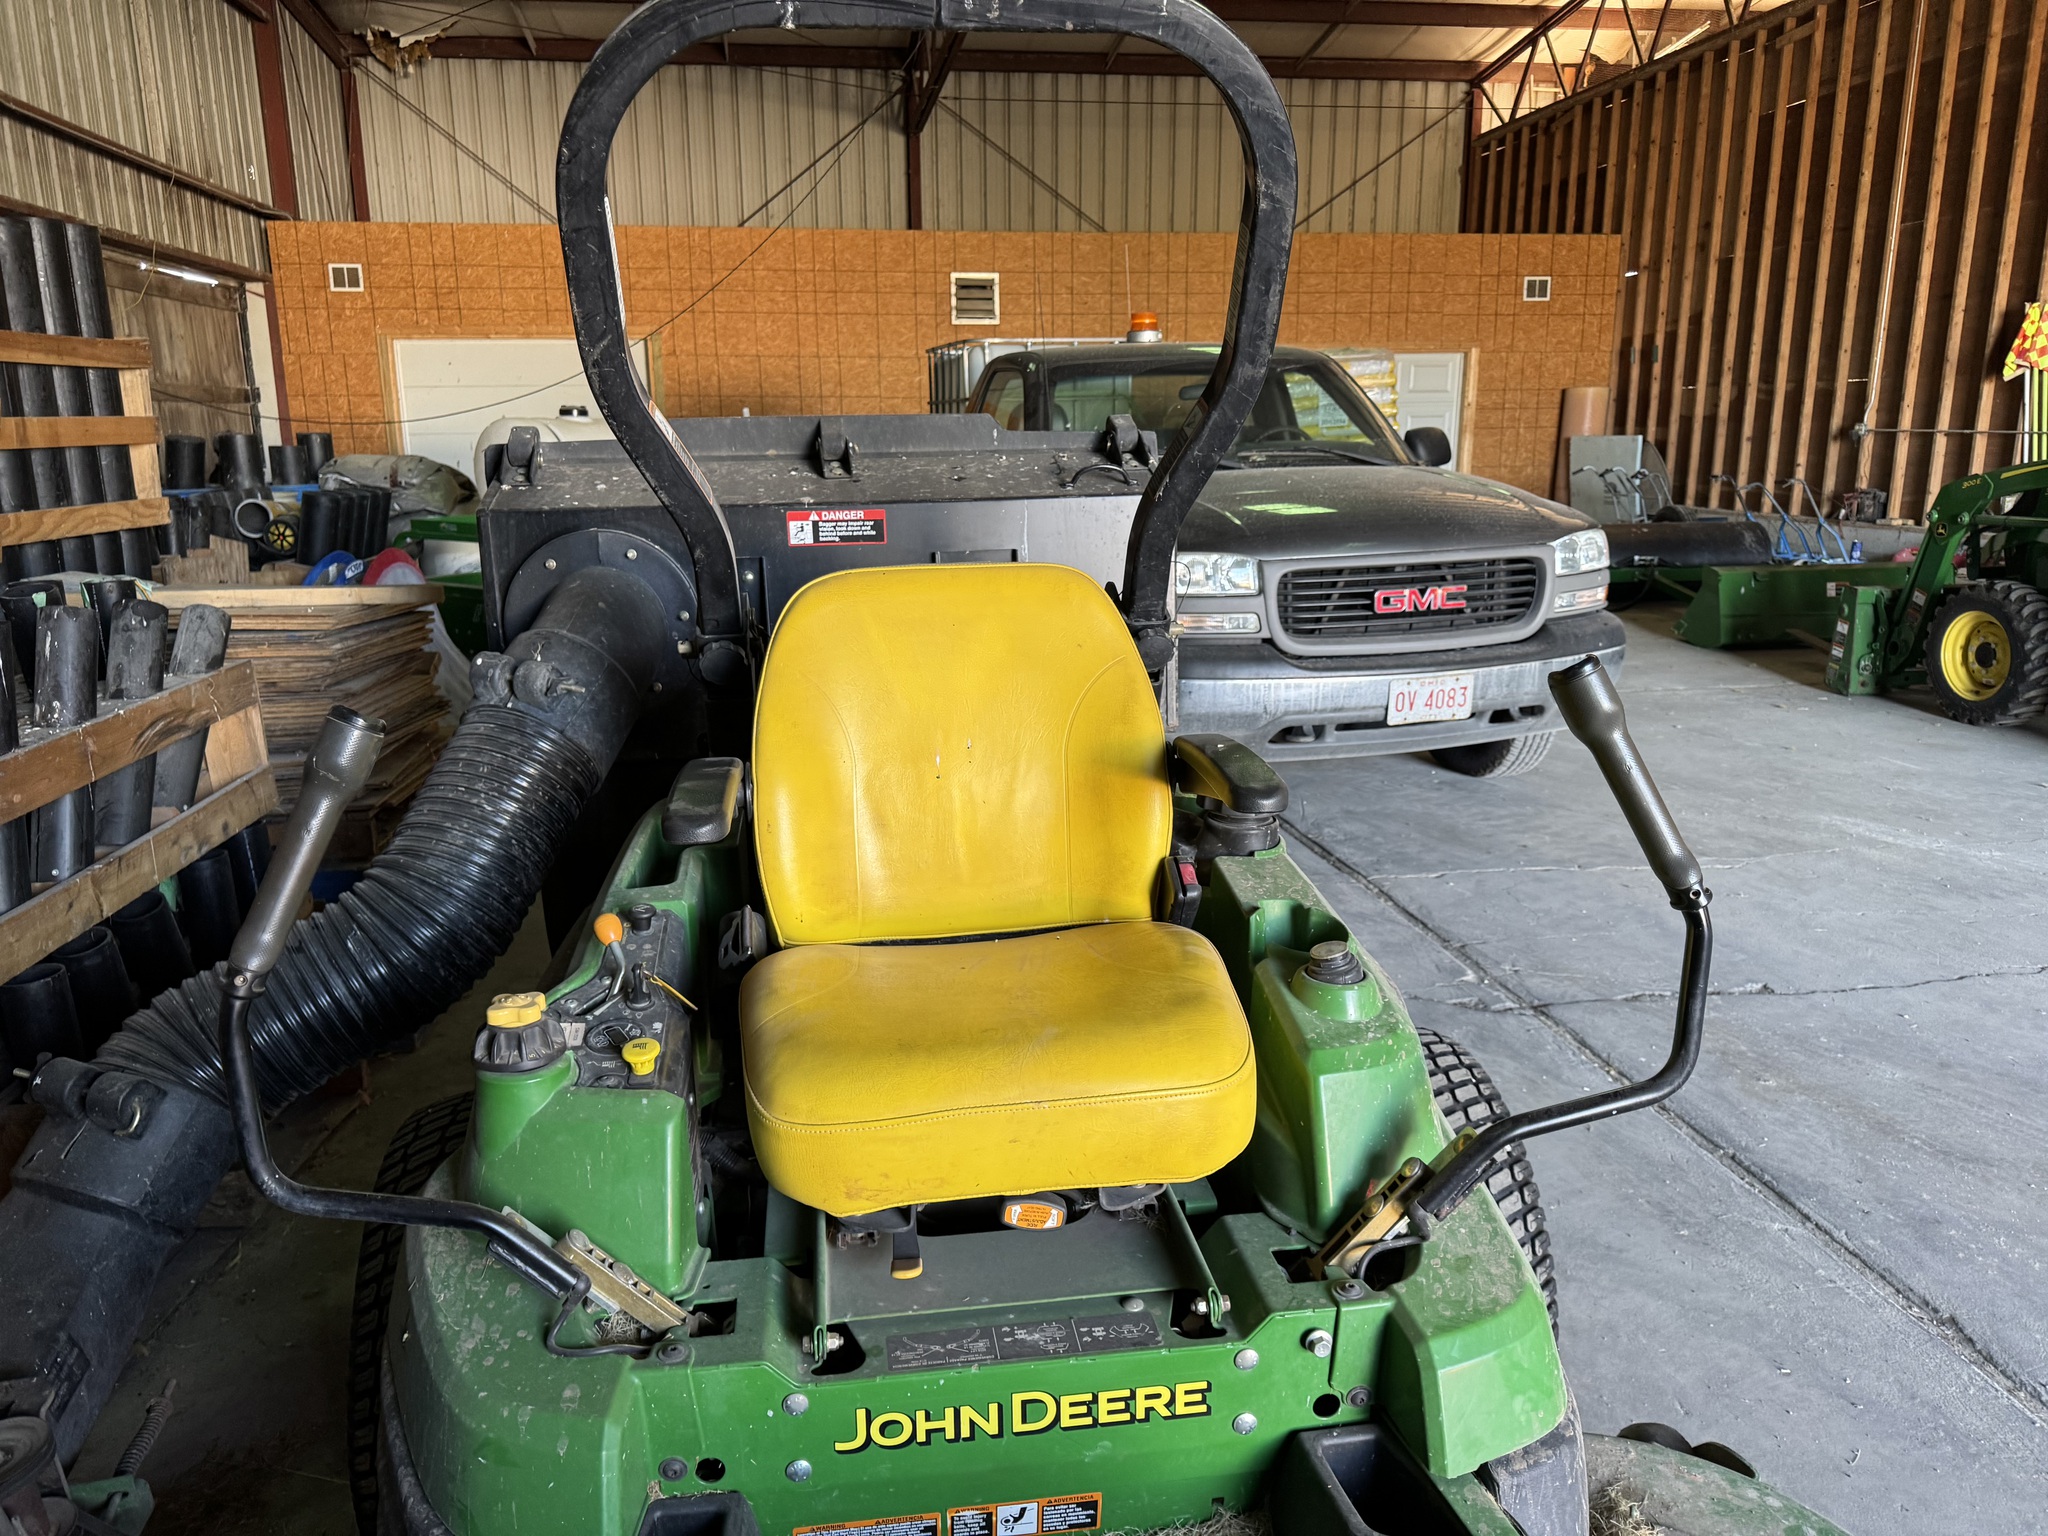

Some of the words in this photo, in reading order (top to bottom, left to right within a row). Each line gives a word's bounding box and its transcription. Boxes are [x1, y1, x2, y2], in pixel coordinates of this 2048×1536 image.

[821, 511, 864, 520] DANGER
[1374, 585, 1468, 614] GMC
[1420, 679, 1445, 687] OHIO
[1425, 686, 1468, 711] 4083
[834, 1402, 1002, 1454] JOHN
[1011, 1380, 1210, 1437] DEERE
[1053, 1495, 1094, 1503] ADVERTENCIA
[880, 1515, 924, 1524] ADVERTENCIA
[815, 1523, 846, 1532] WARNING
